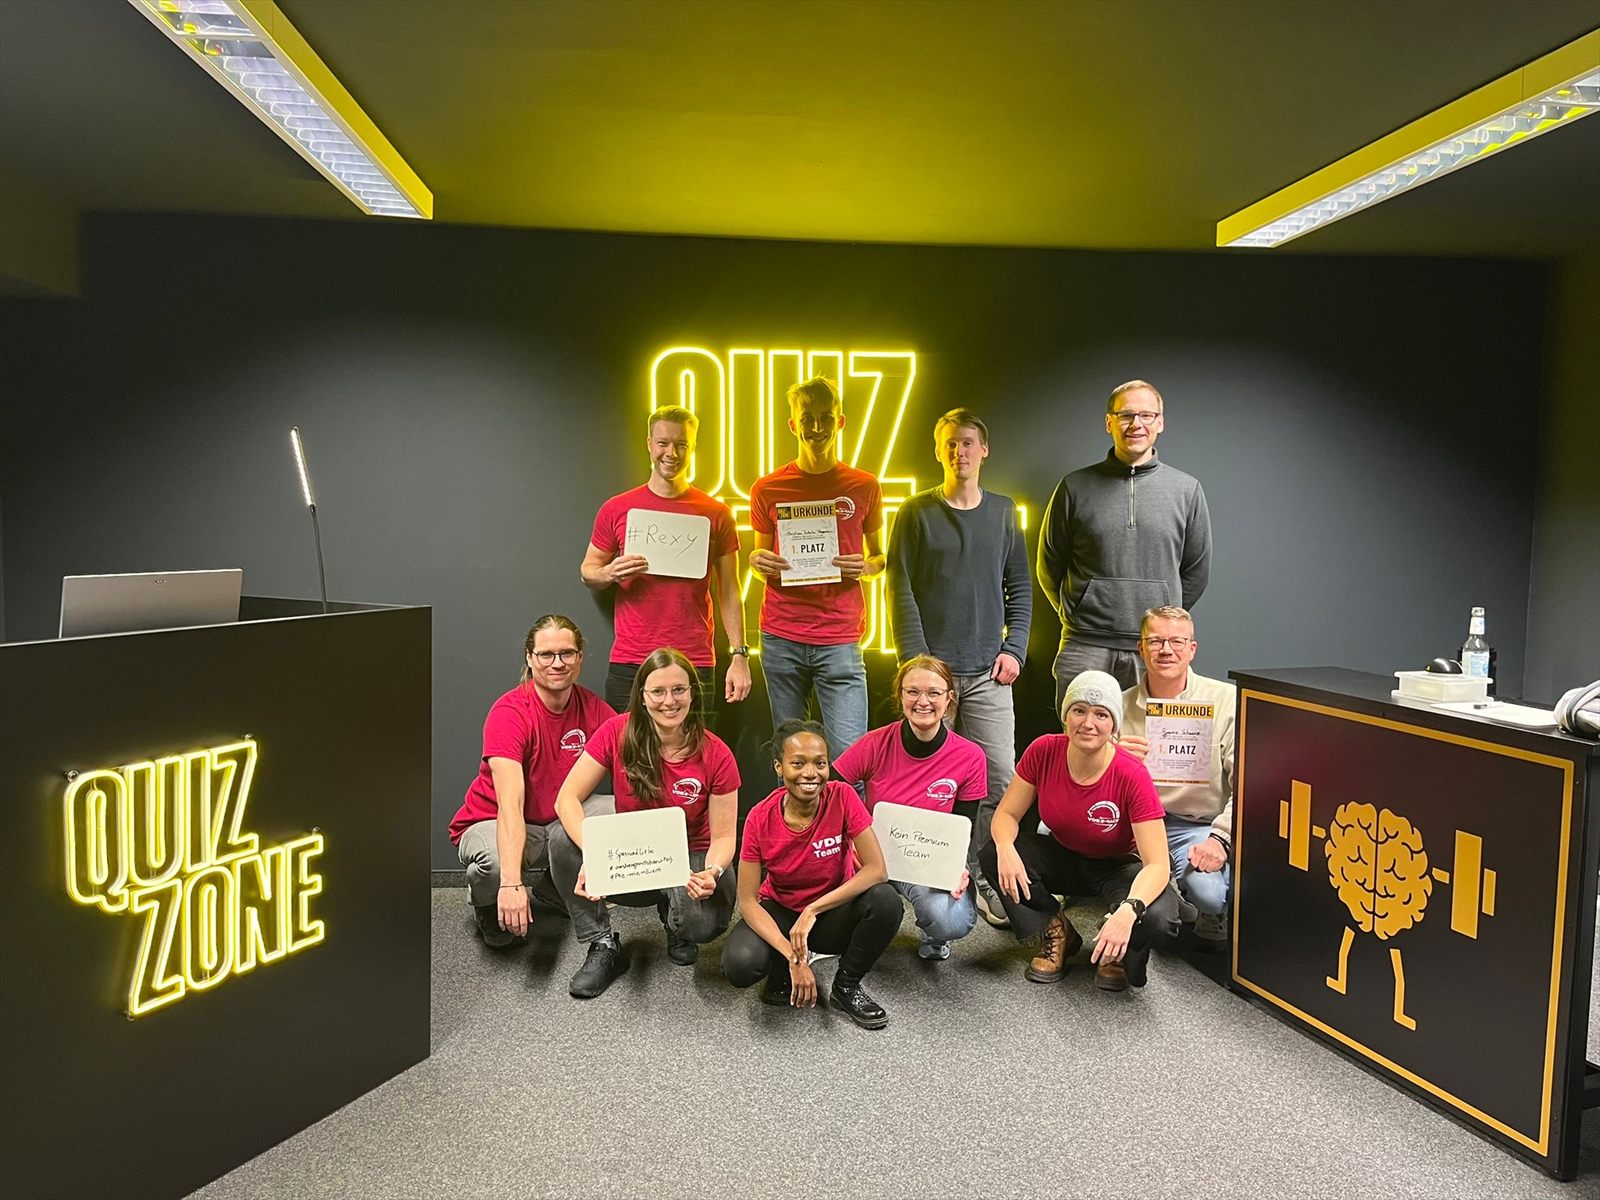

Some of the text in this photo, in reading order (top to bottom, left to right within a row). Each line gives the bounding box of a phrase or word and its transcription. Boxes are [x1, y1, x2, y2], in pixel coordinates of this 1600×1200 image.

[793, 505, 833, 518] URKUNDE
[628, 524, 698, 558] #Rexy
[800, 543, 825, 553] PLATZ
[1165, 705, 1212, 717] URKUNDE
[1168, 744, 1196, 755] PLATZ
[64, 741, 259, 913] QUIZ
[812, 834, 842, 850] VDE
[814, 846, 841, 858] Team
[898, 844, 930, 859] Team
[129, 834, 325, 1016] ZONE
